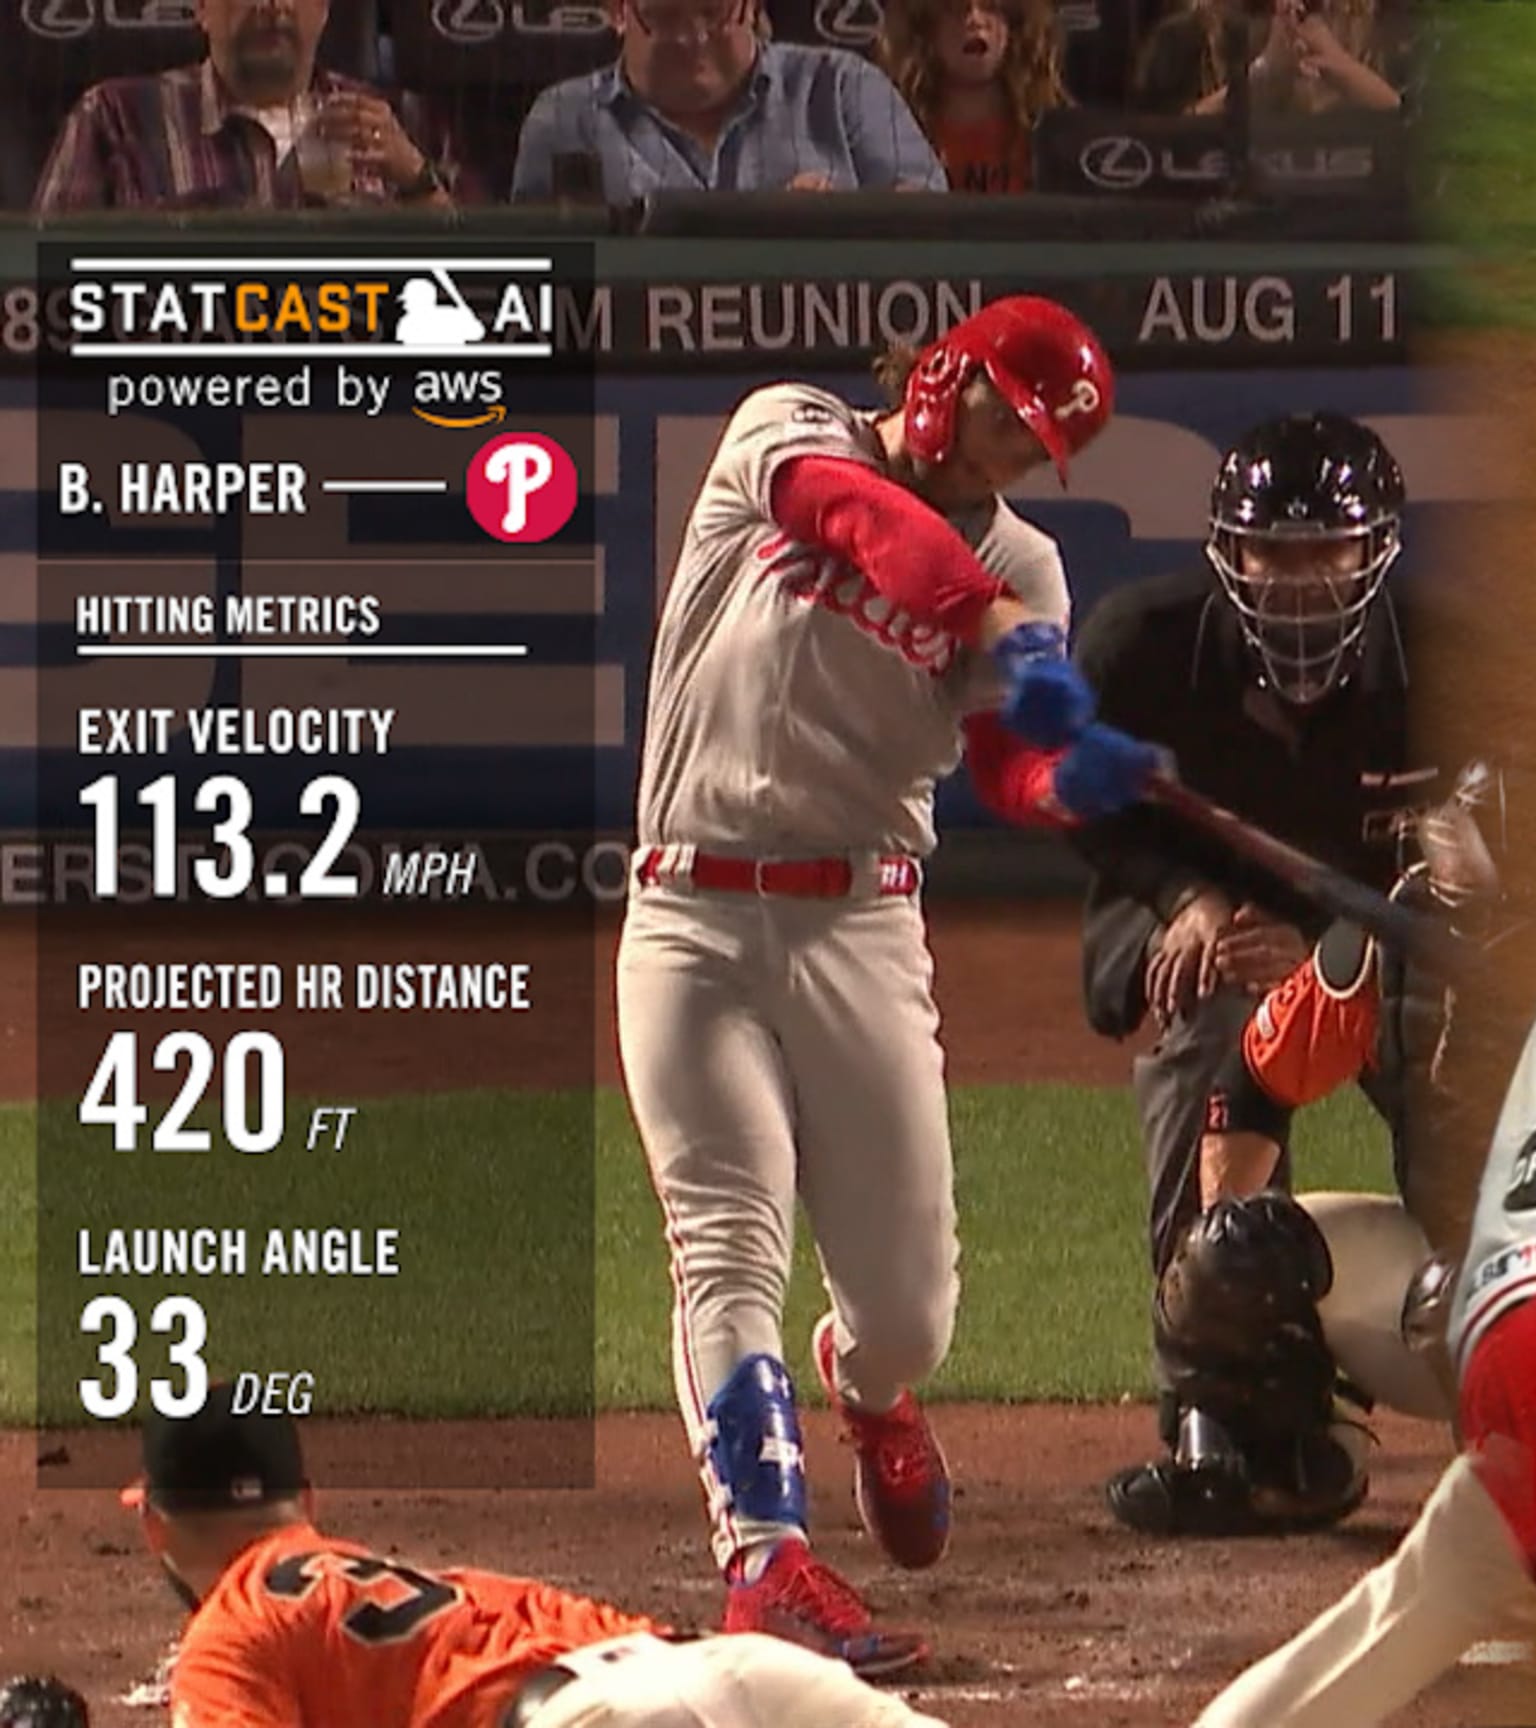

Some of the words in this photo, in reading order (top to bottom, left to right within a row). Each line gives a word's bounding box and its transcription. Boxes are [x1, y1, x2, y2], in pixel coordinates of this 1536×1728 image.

[647, 280, 983, 352] REUNION
[1139, 276, 1294, 341] AUG
[1326, 274, 1396, 341] 11
